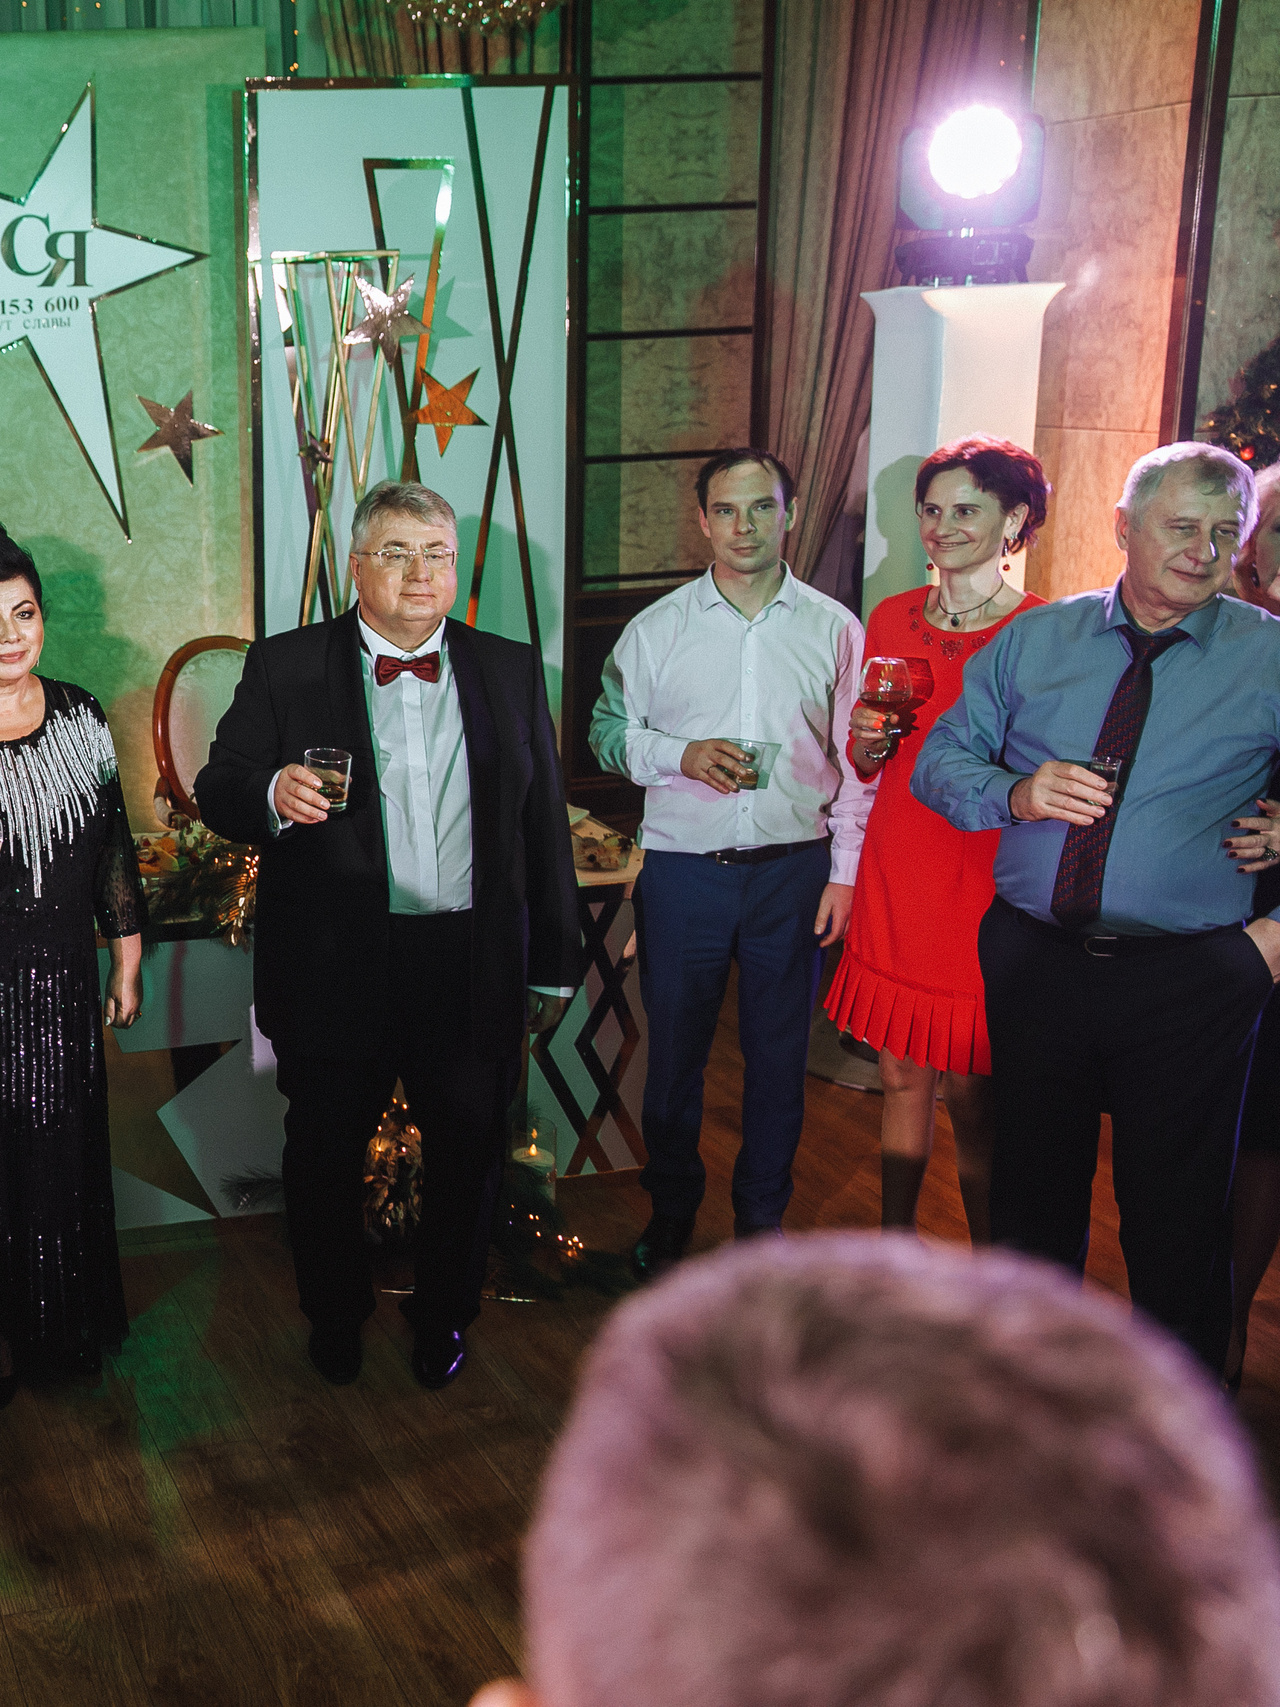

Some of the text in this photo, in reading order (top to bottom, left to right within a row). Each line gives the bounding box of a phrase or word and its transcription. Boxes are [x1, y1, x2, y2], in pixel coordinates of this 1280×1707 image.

[0, 214, 94, 288] СЯ
[44, 295, 80, 313] 600
[22, 316, 71, 331] славы
